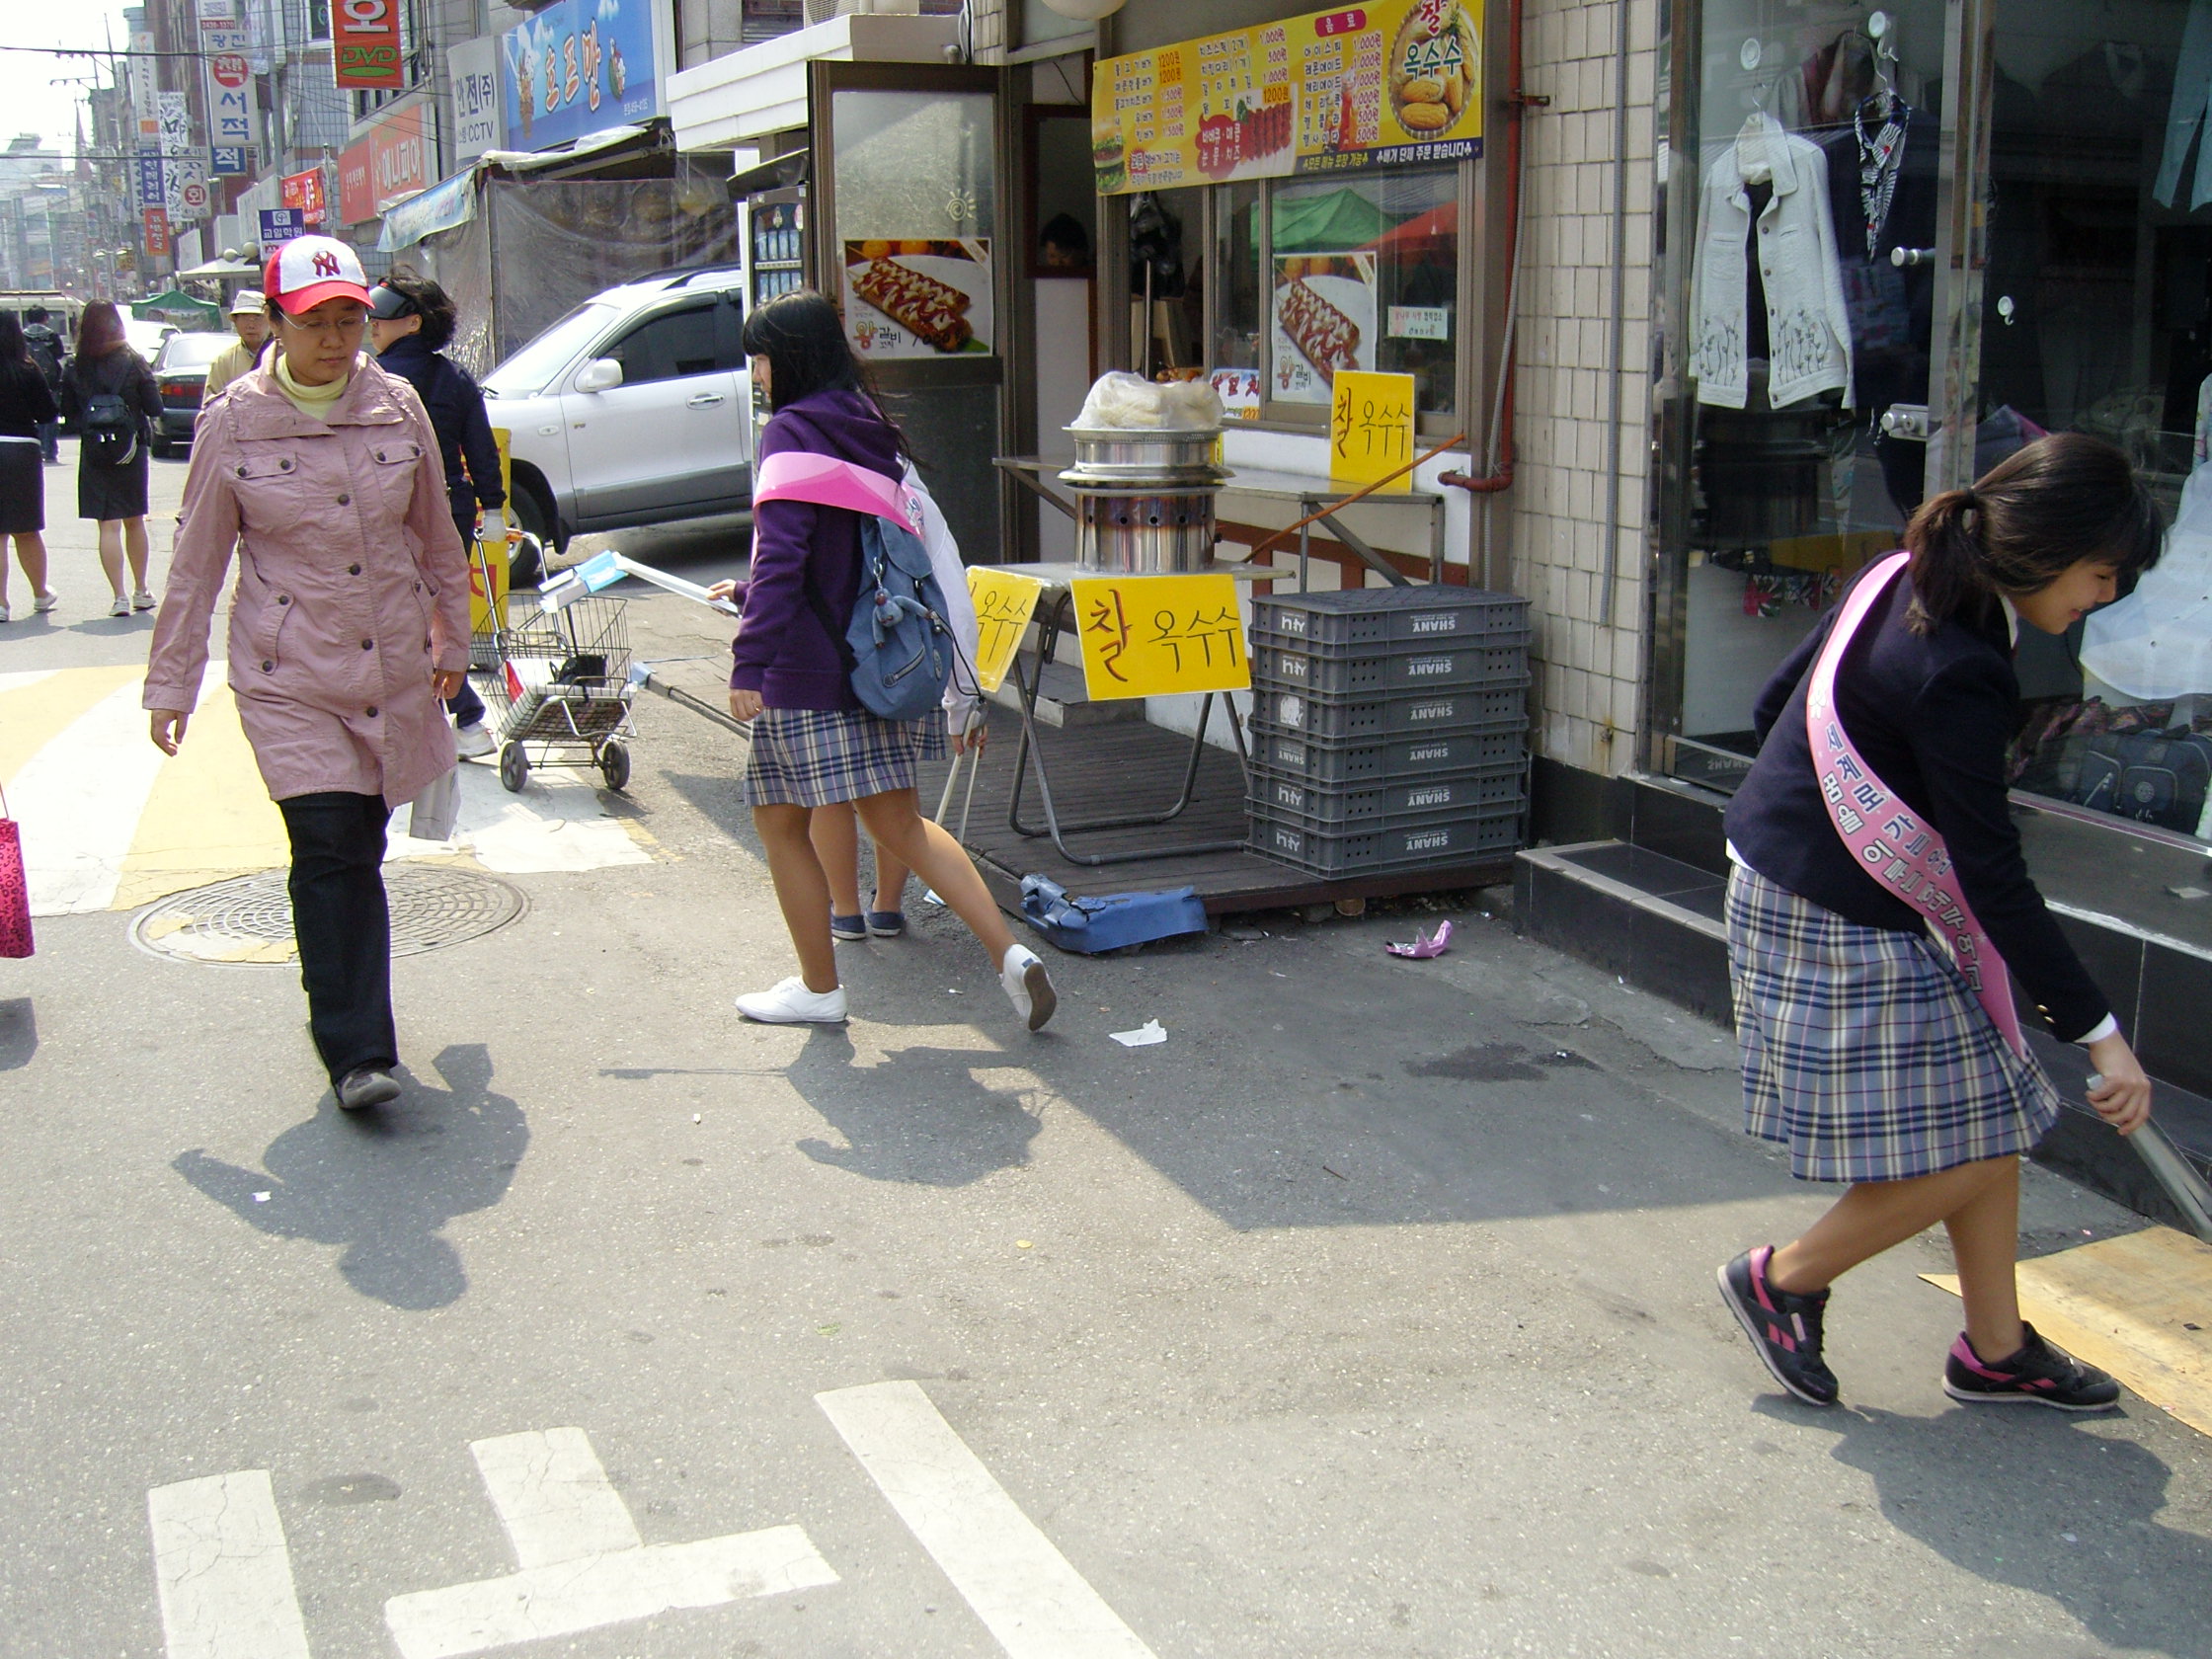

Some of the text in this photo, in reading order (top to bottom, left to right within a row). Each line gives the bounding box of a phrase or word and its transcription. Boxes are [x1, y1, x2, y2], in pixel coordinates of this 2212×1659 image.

[212, 35, 246, 48] 광진
[342, 46, 397, 65] DVD
[1404, 39, 1462, 80] 옥수수
[220, 92, 249, 140] 서적
[468, 120, 494, 141] CCTV
[1416, 145, 1431, 161] 주문
[1433, 142, 1465, 160] 받습니다
[879, 326, 902, 343] 갈비
[1333, 387, 1410, 461] 찰 옥수수
[976, 591, 1027, 672] 옥수수
[1086, 589, 1240, 682] 찰 옥수수
[1412, 619, 1456, 633] SHANY
[1408, 662, 1453, 675] SHANY
[1410, 705, 1454, 721] SHANY
[1278, 750, 1304, 765] SHANY
[1409, 748, 1449, 761] SHANY
[1407, 791, 1451, 807] SHANY
[1825, 723, 1932, 857] 세계로 가는
[1823, 771, 1864, 835] 꿈을
[1406, 835, 1449, 851] SHANY
